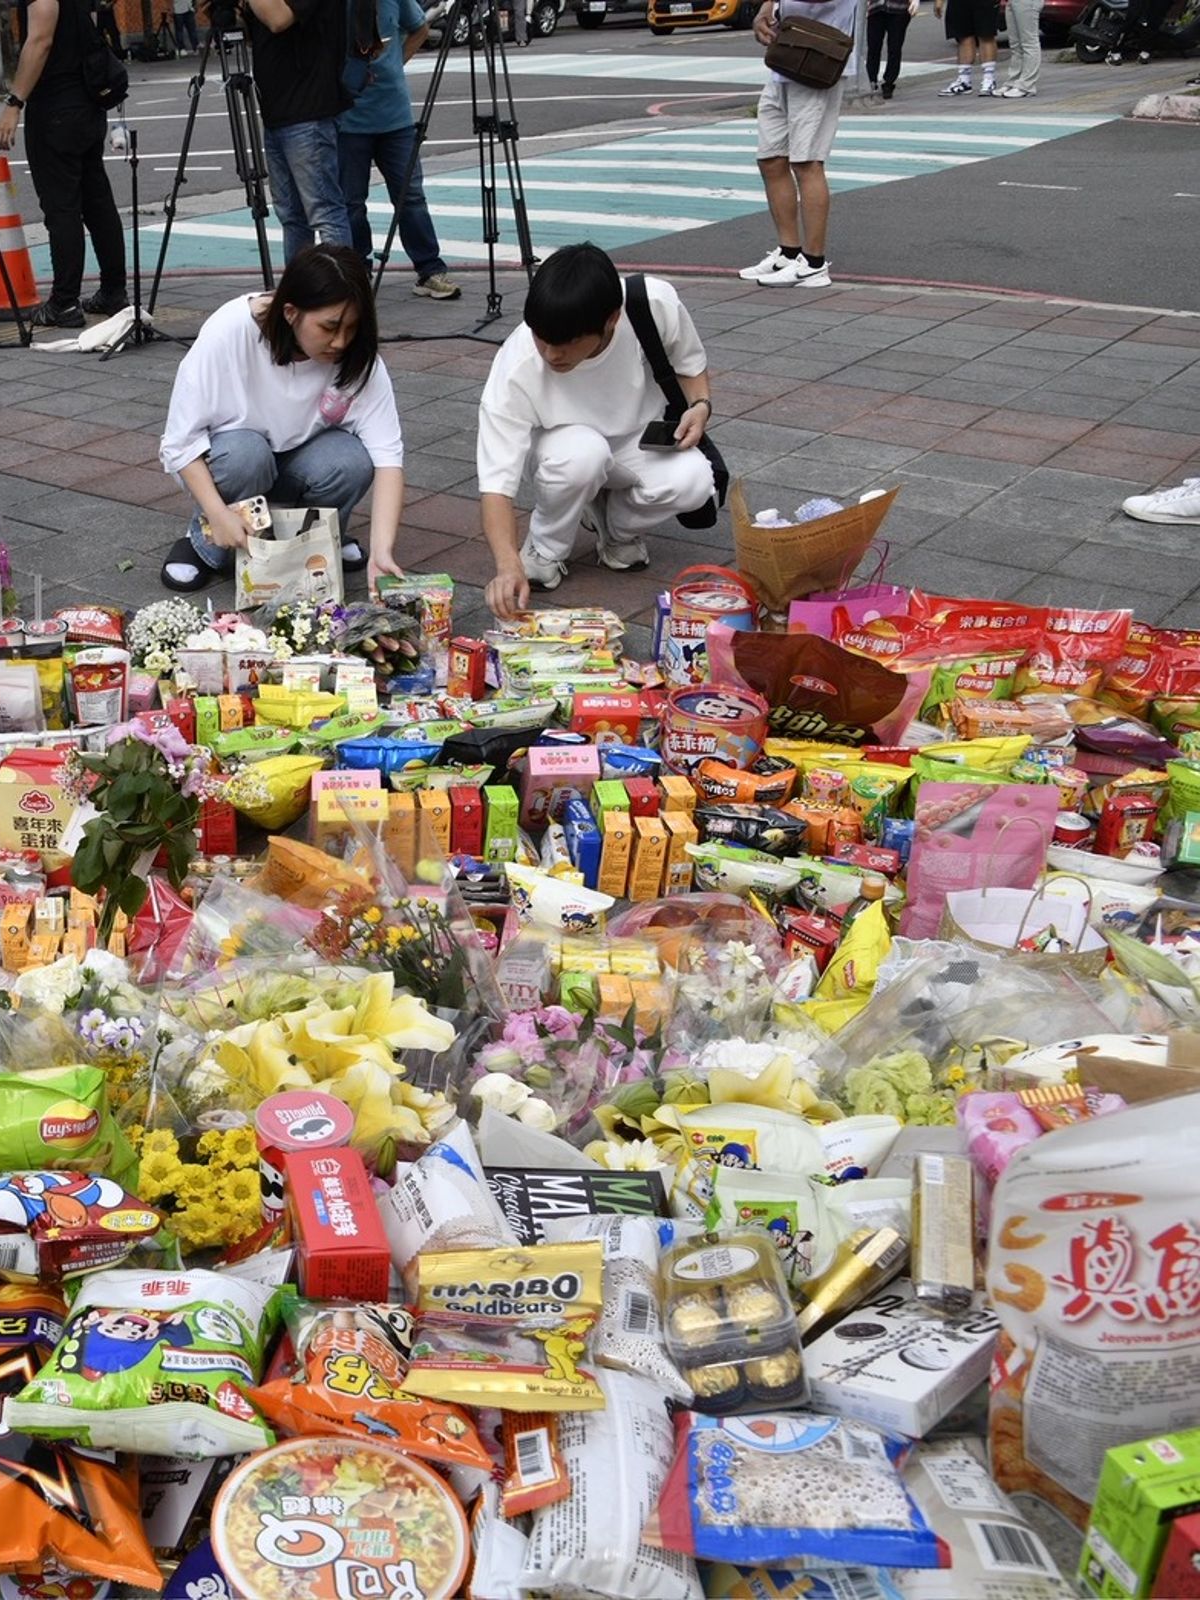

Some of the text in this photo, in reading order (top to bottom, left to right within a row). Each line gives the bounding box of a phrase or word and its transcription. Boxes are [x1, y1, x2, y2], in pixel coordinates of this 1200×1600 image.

[669, 734, 717, 754] 乖乖桶
[13, 816, 64, 834] 喜年來
[20, 833, 59, 850] 蛋捲
[274, 1102, 327, 1124] PRINGLES
[1062, 1195, 1114, 1208] 華元
[141, 1281, 191, 1297] 乖乖
[433, 1274, 579, 1302] HARIBO
[445, 1300, 563, 1315] Goldbears
[526, 1383, 541, 1392] Net
[543, 1384, 569, 1395] weight
[255, 1513, 425, 1600] 阿Q
